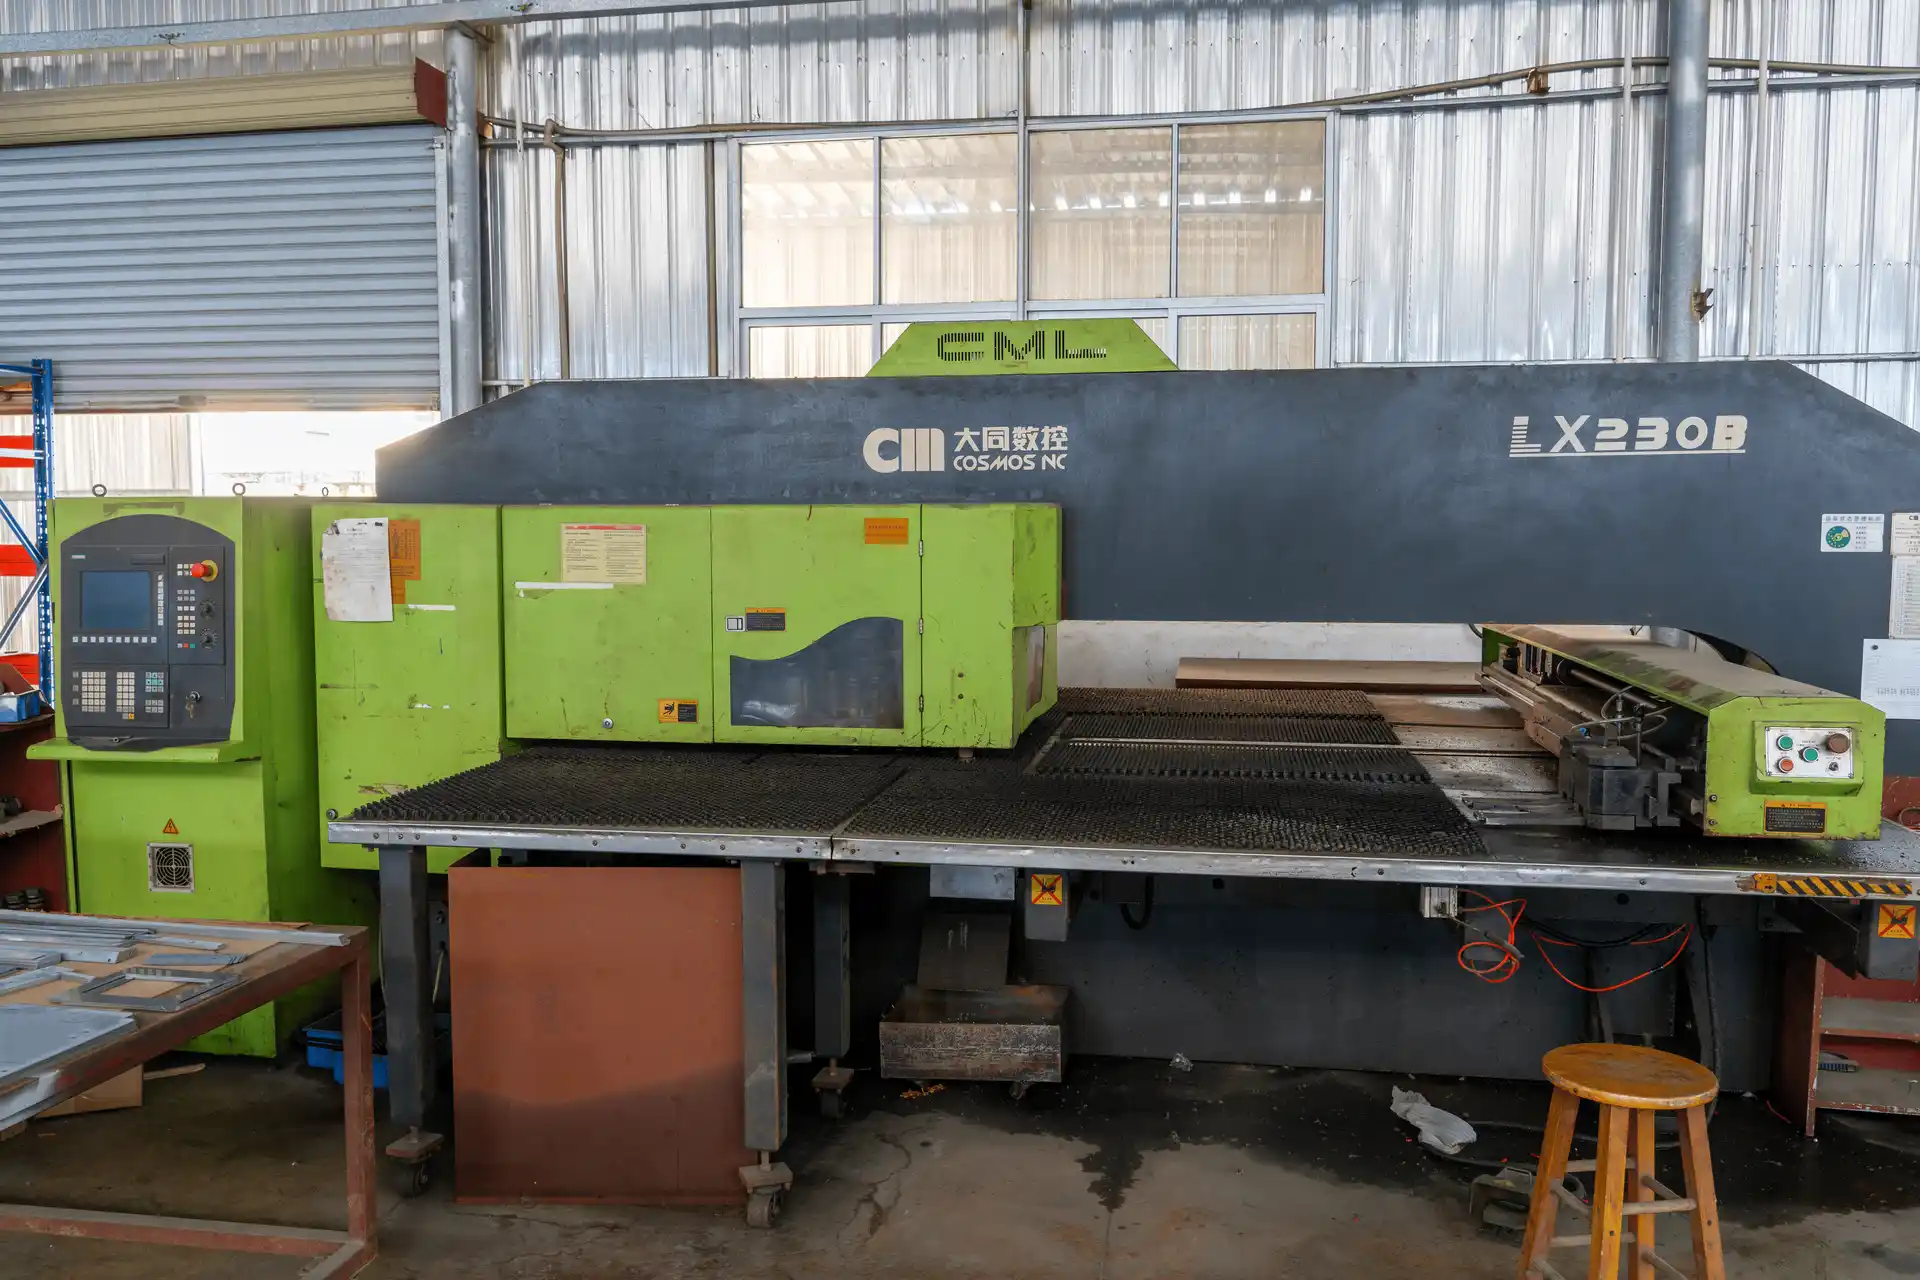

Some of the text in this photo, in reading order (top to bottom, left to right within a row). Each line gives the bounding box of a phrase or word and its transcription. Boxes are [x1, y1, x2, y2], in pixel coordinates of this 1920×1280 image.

[937, 330, 1107, 362] CML
[953, 425, 1068, 452] 大同数控
[1509, 415, 1748, 453] LX230B
[953, 453, 1067, 472] COSMOS NC
